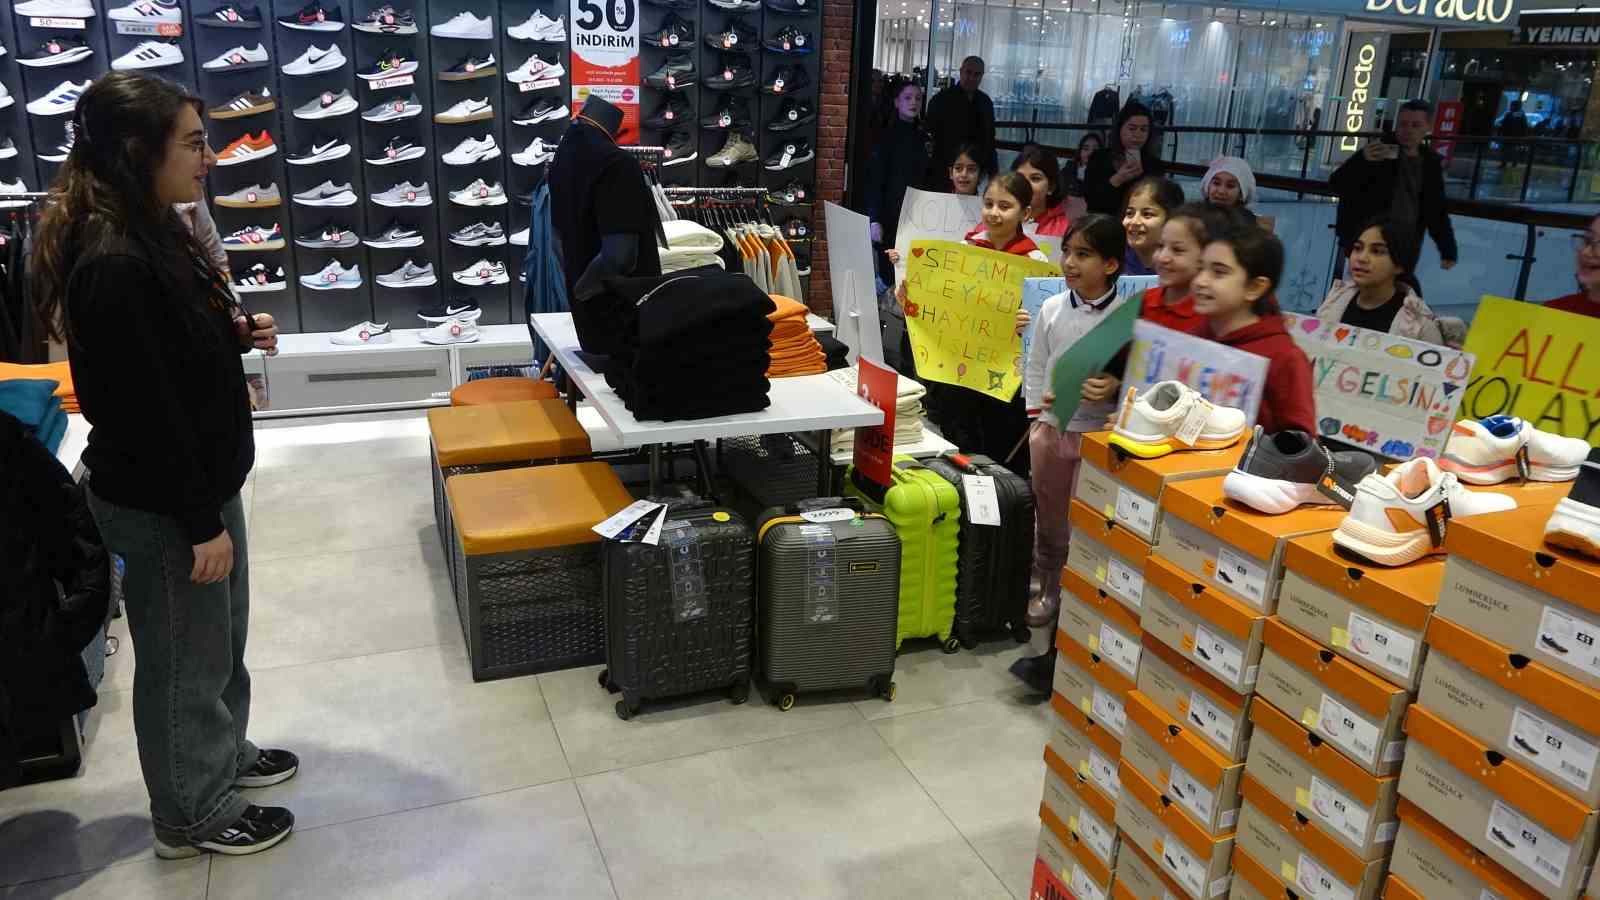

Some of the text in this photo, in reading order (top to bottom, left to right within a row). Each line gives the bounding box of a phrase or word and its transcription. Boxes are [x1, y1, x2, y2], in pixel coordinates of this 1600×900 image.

[1341, 44, 1376, 152] DeFacto
[921, 248, 1009, 283] SELAM
[910, 272, 1022, 314] ALEYKÜ
[1493, 328, 1600, 399] ALL
[1454, 582, 1510, 612] LUMBERJACK
